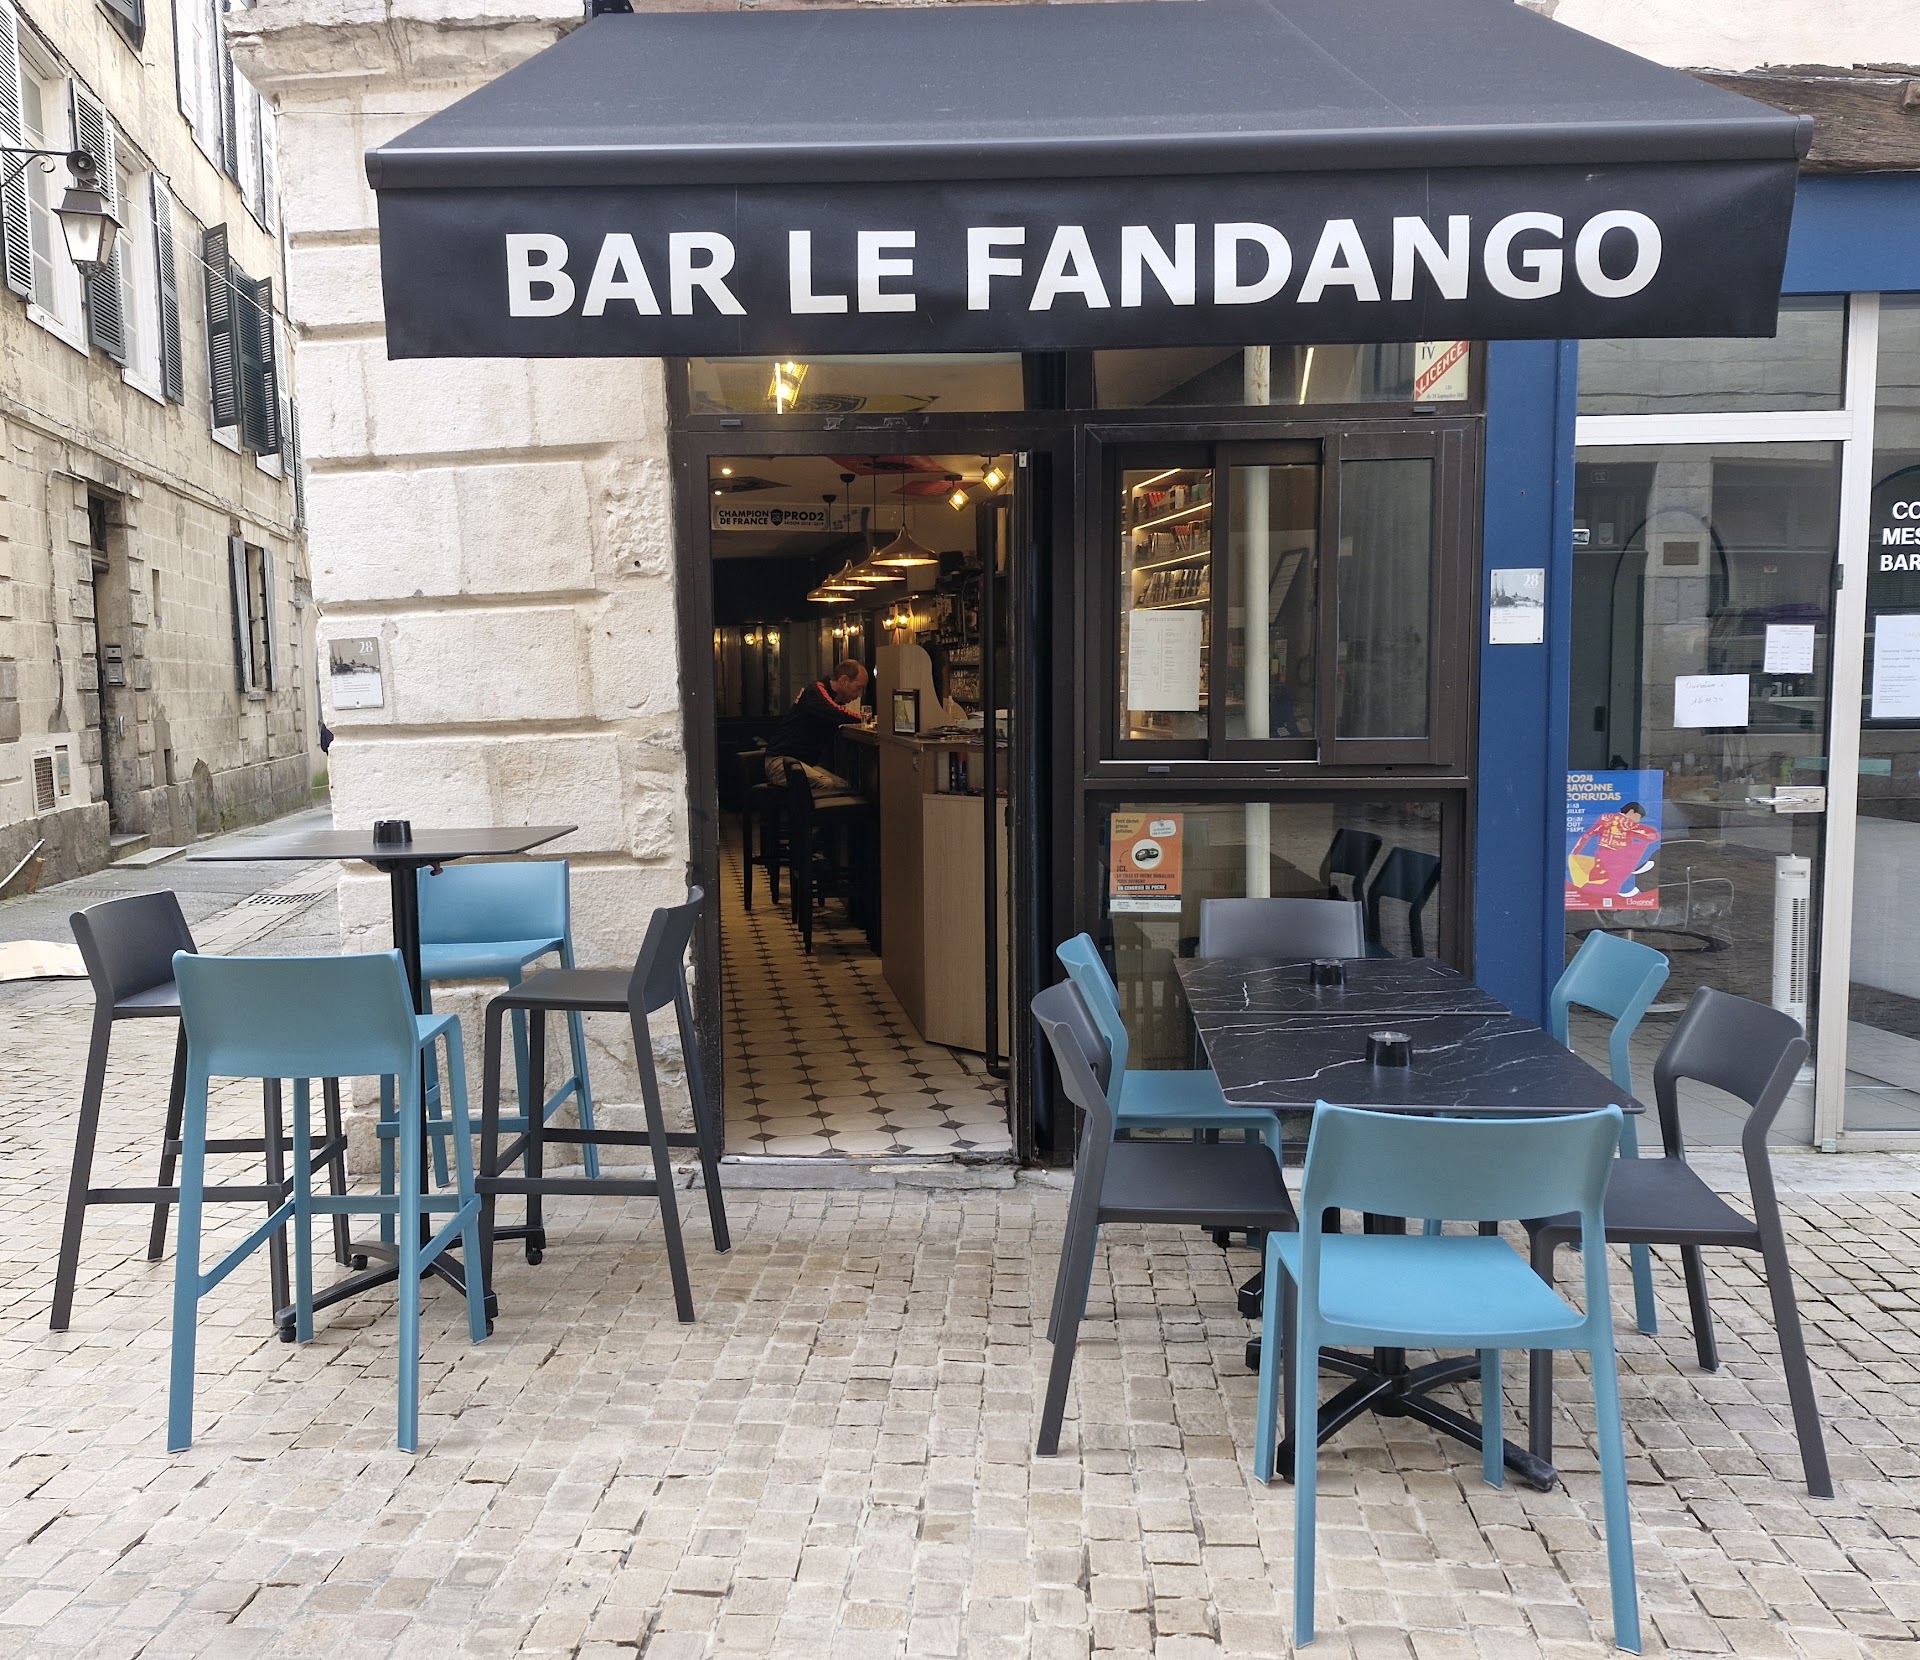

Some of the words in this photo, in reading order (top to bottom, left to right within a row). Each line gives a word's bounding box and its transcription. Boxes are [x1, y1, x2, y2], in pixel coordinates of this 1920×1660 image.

[505, 232, 747, 317] BAR
[788, 230, 917, 313] LE
[967, 209, 1662, 311] FANDANGO
[1421, 346, 1436, 360] IV
[1419, 341, 1464, 391] LICENCE
[718, 510, 769, 518] CHAMPION
[784, 510, 824, 521] PROD2
[720, 517, 732, 525] DE
[733, 517, 768, 525] FRANCE
[1523, 573, 1539, 587] 28
[359, 640, 373, 653] 28
[1566, 774, 1594, 783] 2024
[1566, 783, 1613, 792] BAYONNE
